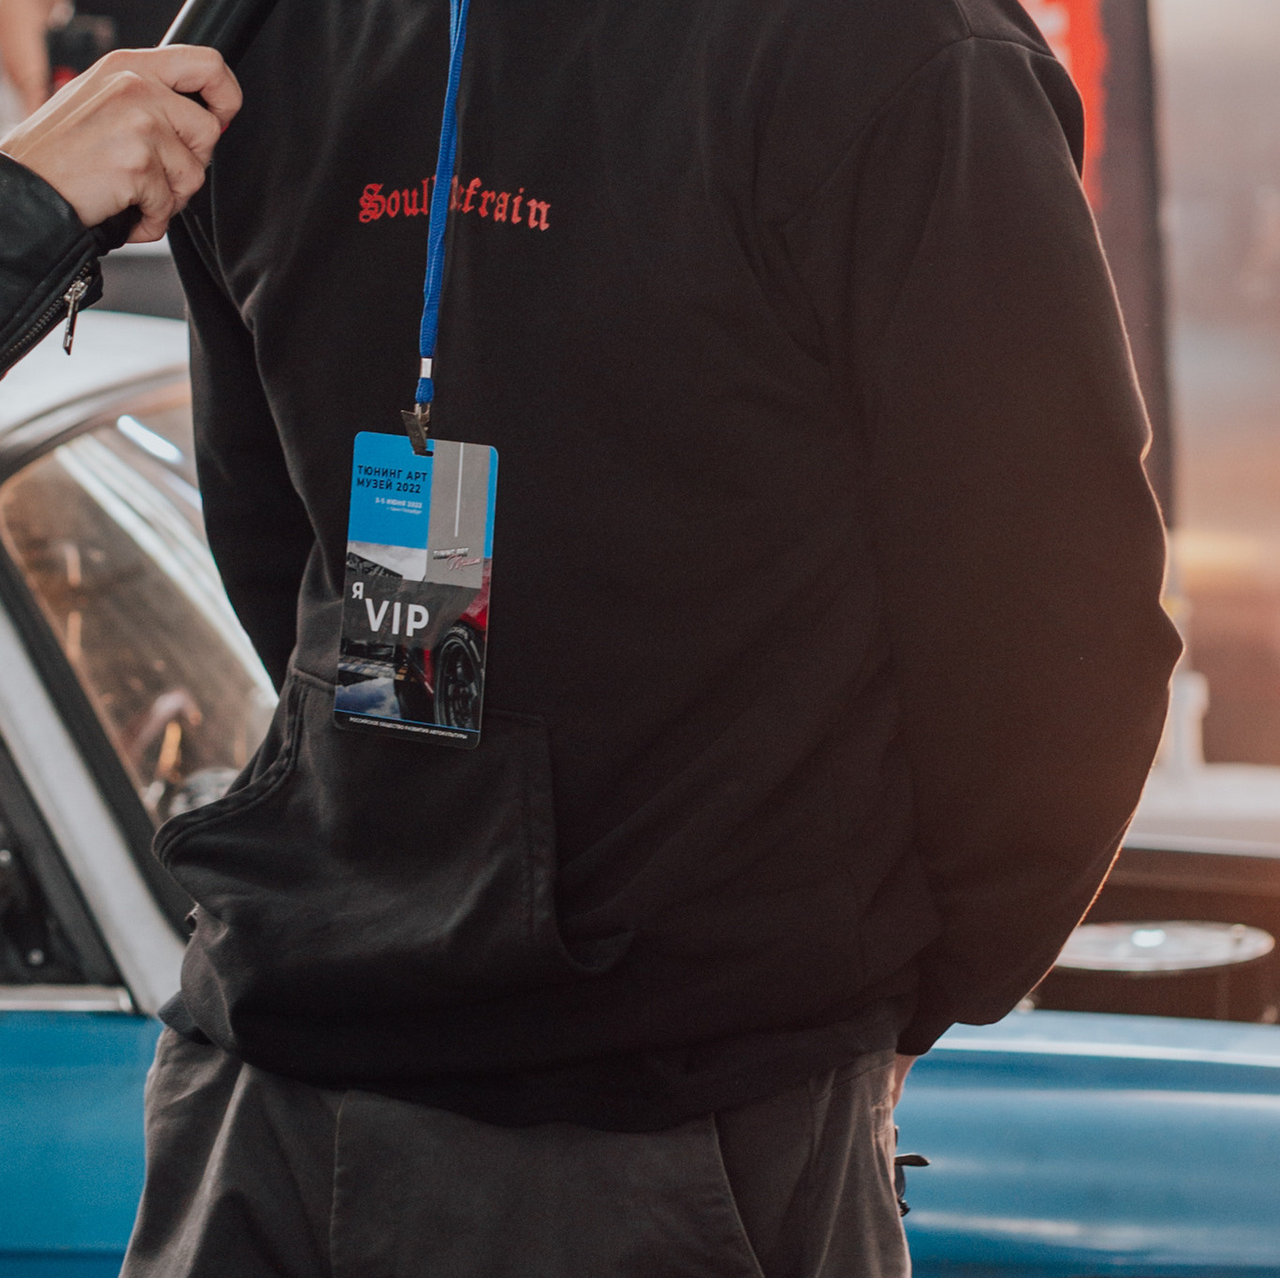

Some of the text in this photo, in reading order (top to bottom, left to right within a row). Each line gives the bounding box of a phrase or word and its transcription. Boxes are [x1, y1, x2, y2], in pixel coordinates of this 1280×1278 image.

[357, 465, 428, 482] ТЮНИНГ АРТ
[356, 477, 421, 494] МУЗЕЙ 2022
[351, 581, 364, 600] Я
[364, 597, 430, 638] VIP
